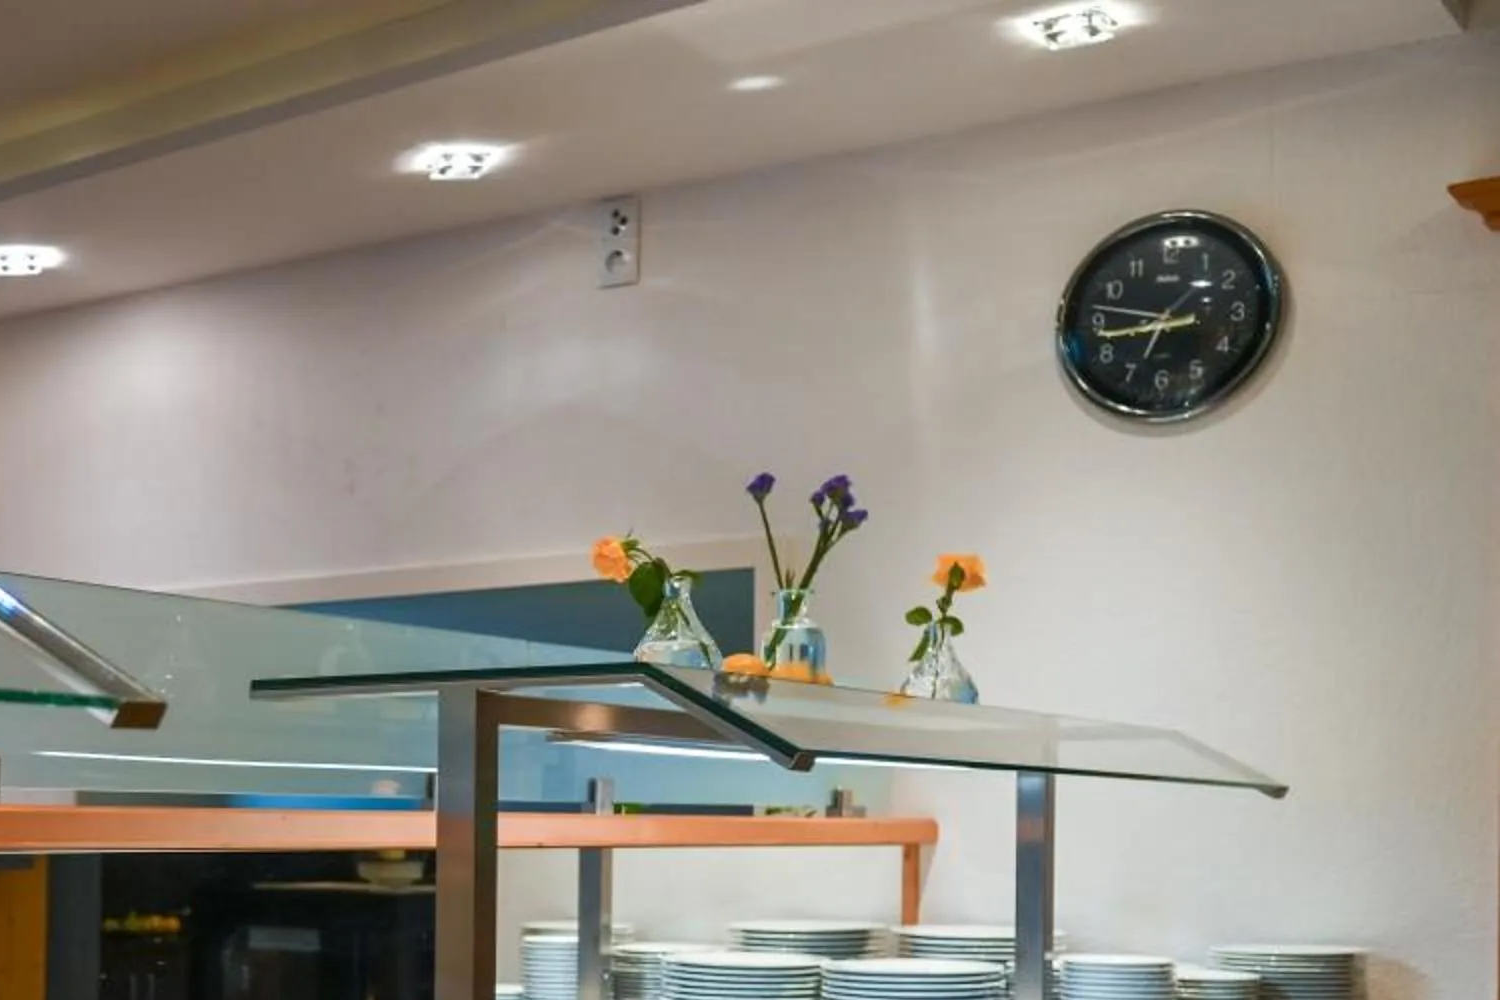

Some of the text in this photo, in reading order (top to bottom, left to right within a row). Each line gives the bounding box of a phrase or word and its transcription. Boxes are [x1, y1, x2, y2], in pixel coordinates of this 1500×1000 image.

[1129, 259, 1144, 278] 11
[1202, 253, 1210, 271] 1
[1221, 269, 1236, 290] 2
[1106, 279, 1124, 300] 10
[1230, 302, 1245, 321] 3
[1092, 312, 1106, 335] 9
[1100, 343, 1114, 363] 8
[1215, 335, 1230, 353] 4
[1125, 363, 1137, 382] 7
[1154, 370, 1169, 388] 6
[1188, 359, 1204, 380] 5
